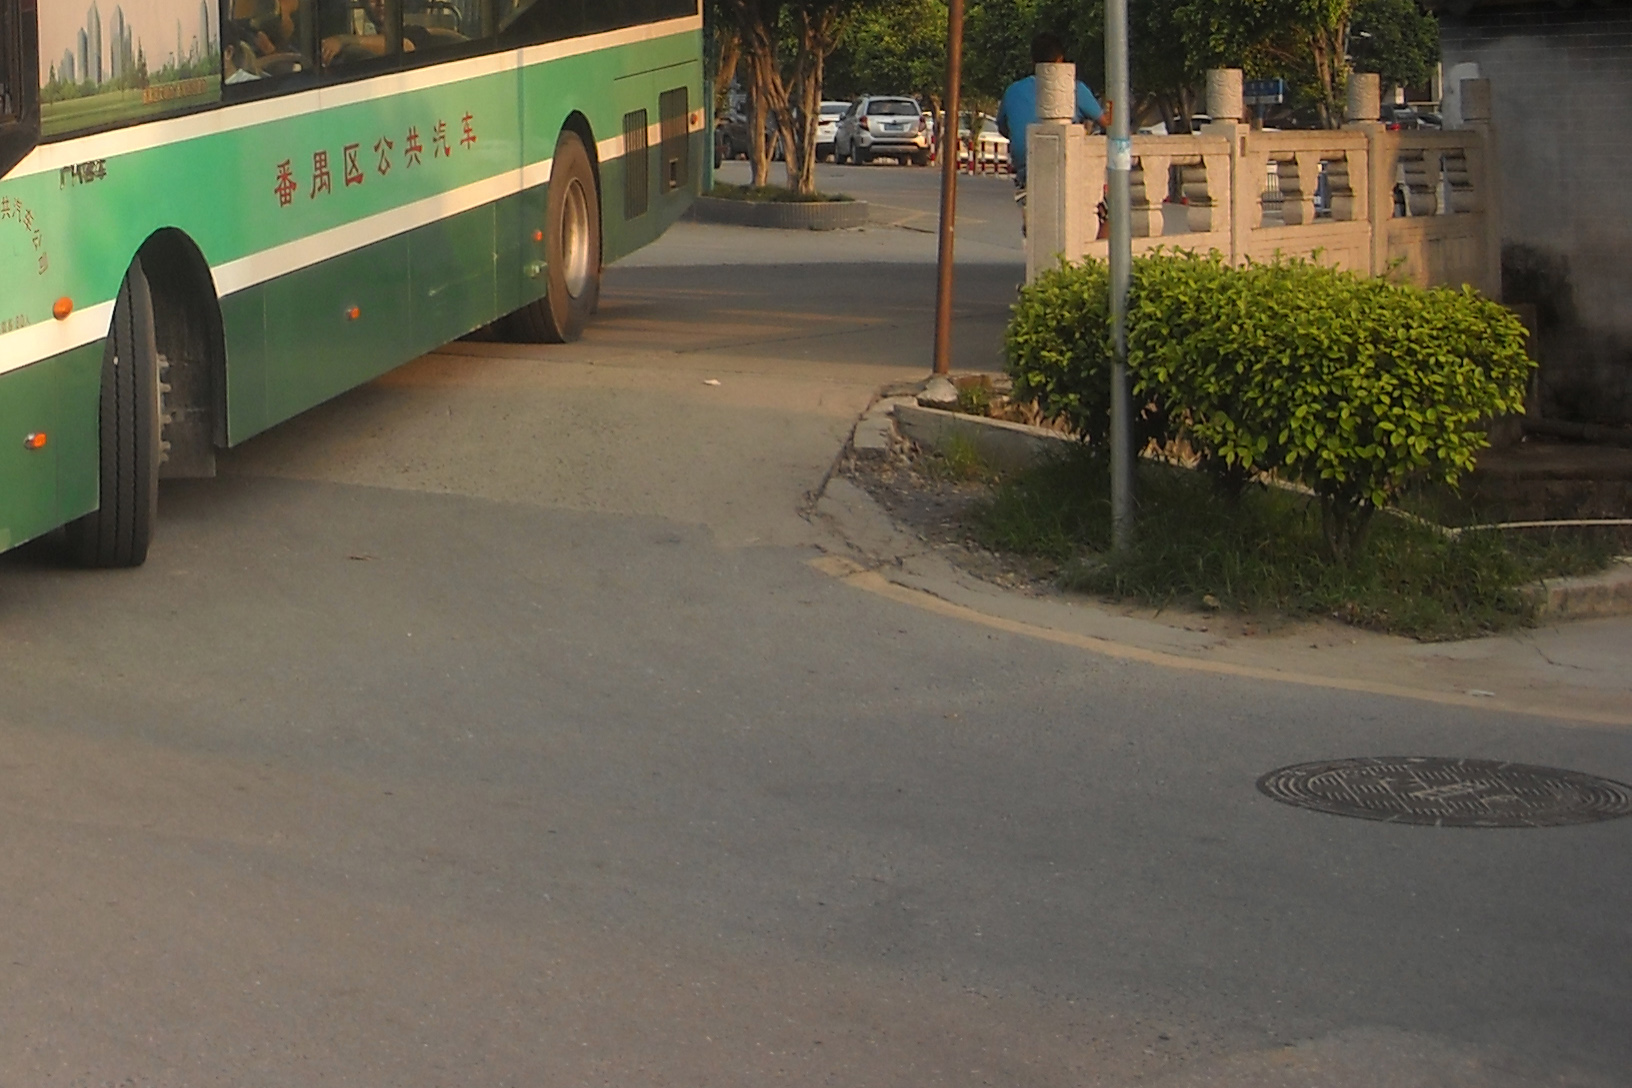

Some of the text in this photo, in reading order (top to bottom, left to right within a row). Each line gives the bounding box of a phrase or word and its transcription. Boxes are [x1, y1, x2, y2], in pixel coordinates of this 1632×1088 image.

[274, 111, 476, 208] 番禺区公共汽车
